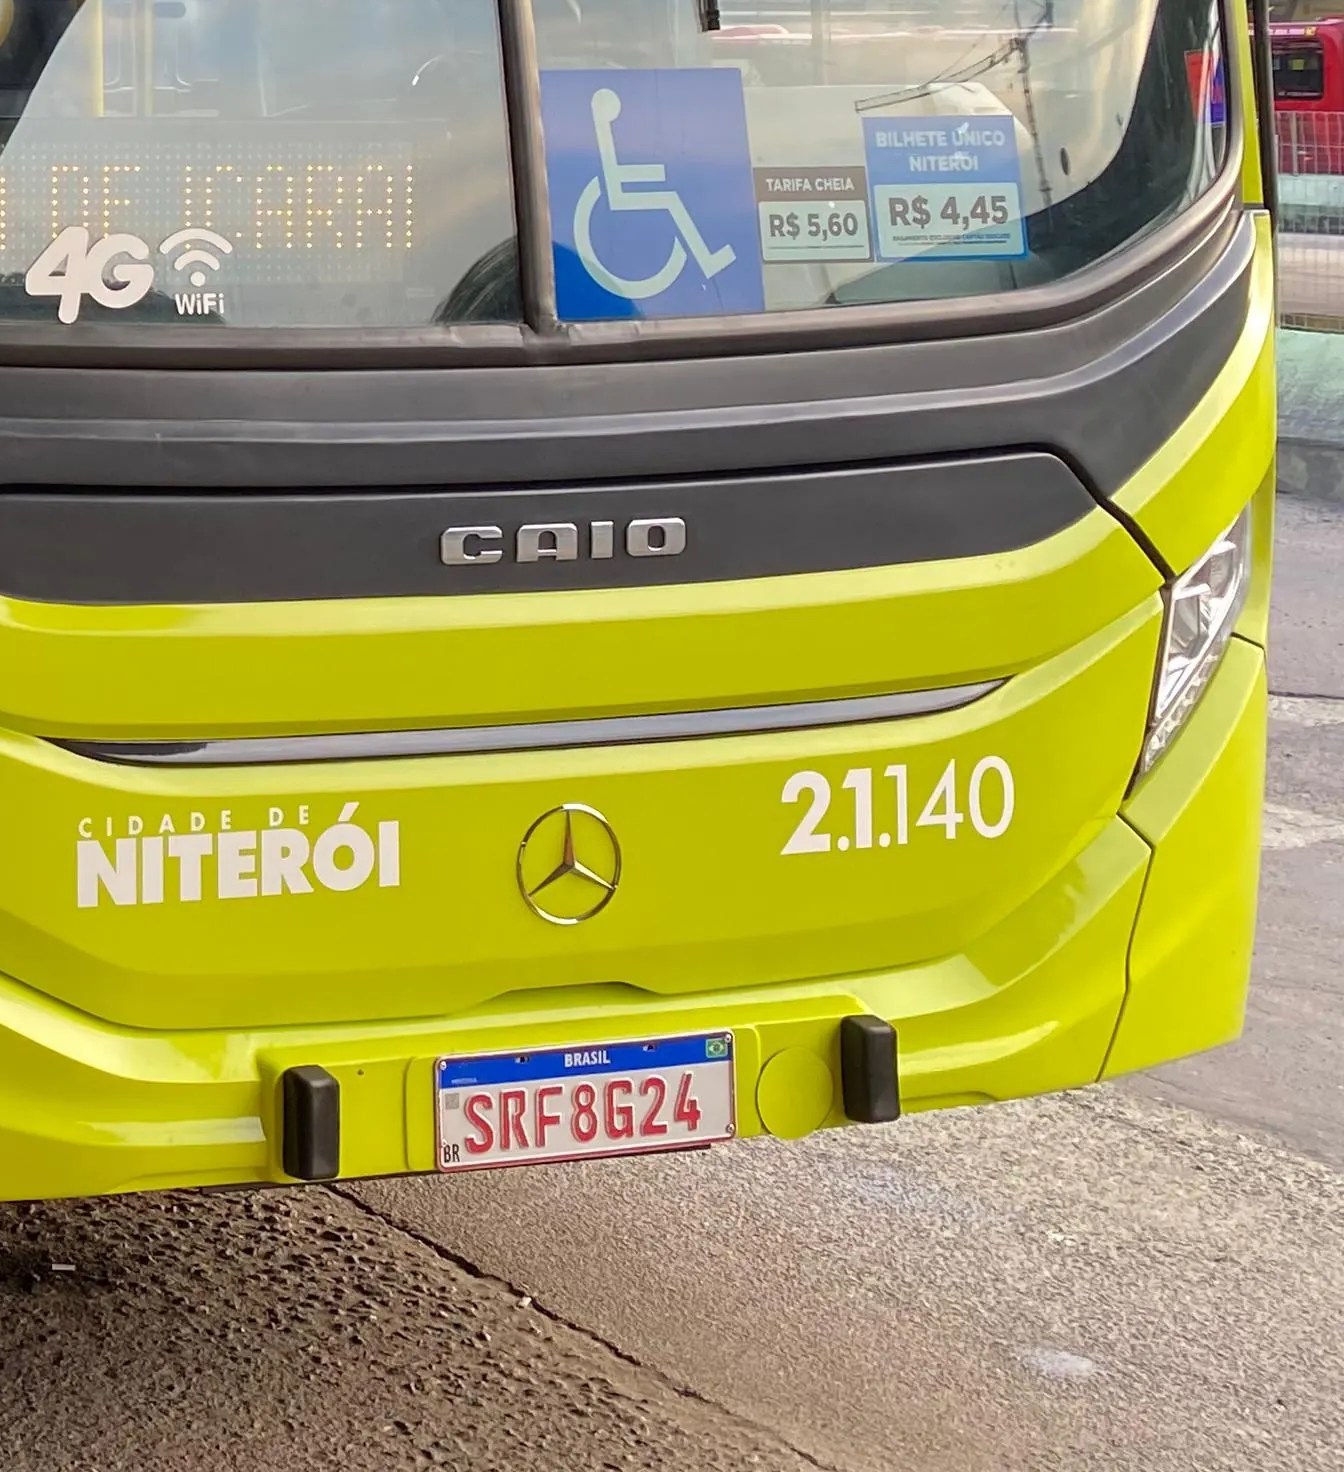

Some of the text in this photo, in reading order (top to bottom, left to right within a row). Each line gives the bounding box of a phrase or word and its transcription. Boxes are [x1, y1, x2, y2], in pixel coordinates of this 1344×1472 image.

[875, 130, 949, 148] BILHETE
[765, 176, 856, 192] TARIFA CHEIA
[769, 212, 859, 241] R$ 5,60
[888, 194, 1009, 230] R$ 4,45
[24, 225, 154, 325] 4G
[174, 292, 226, 316] WiFi
[439, 515, 688, 567] CAIO
[78, 804, 311, 839] CIDADE DE
[780, 755, 1015, 856] 2.1.140
[76, 801, 400, 909] NITERÓI
[564, 1050, 611, 1068] BRASIL
[464, 1072, 703, 1156] SRF8G24
[443, 1143, 461, 1163] BR
